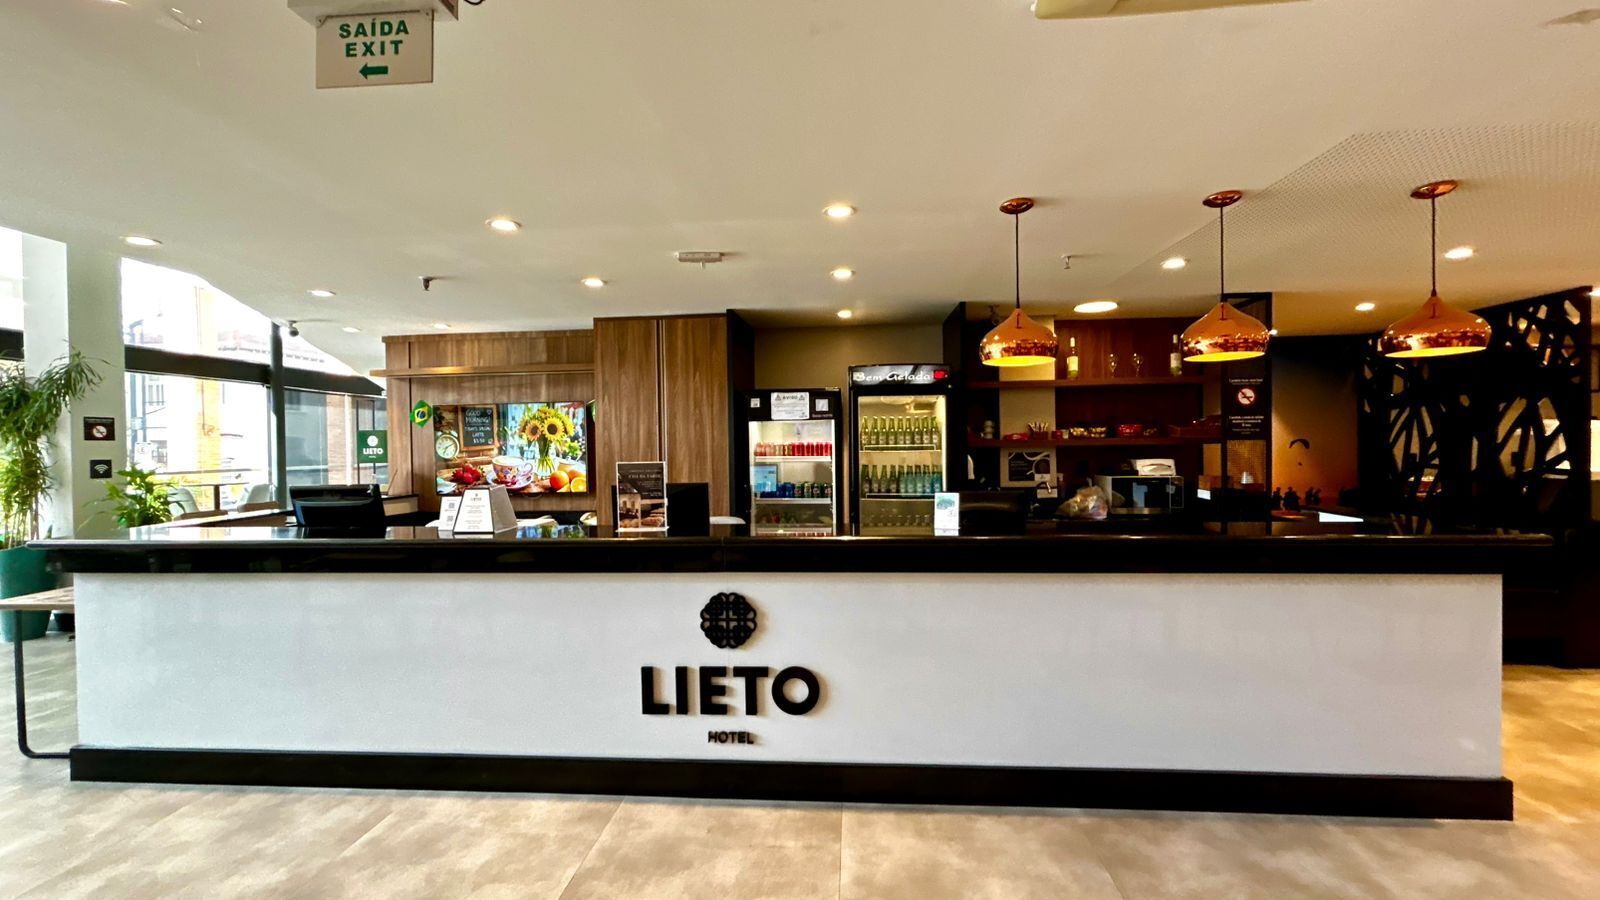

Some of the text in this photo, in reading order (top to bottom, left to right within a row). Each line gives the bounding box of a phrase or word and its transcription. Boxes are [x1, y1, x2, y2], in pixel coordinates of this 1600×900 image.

[339, 18, 409, 39] SAÍDA
[345, 40, 403, 57] EXIT
[854, 371, 931, 381] Bem Gelada
[641, 666, 820, 715] LIETO
[708, 731, 754, 744] HOTEL
